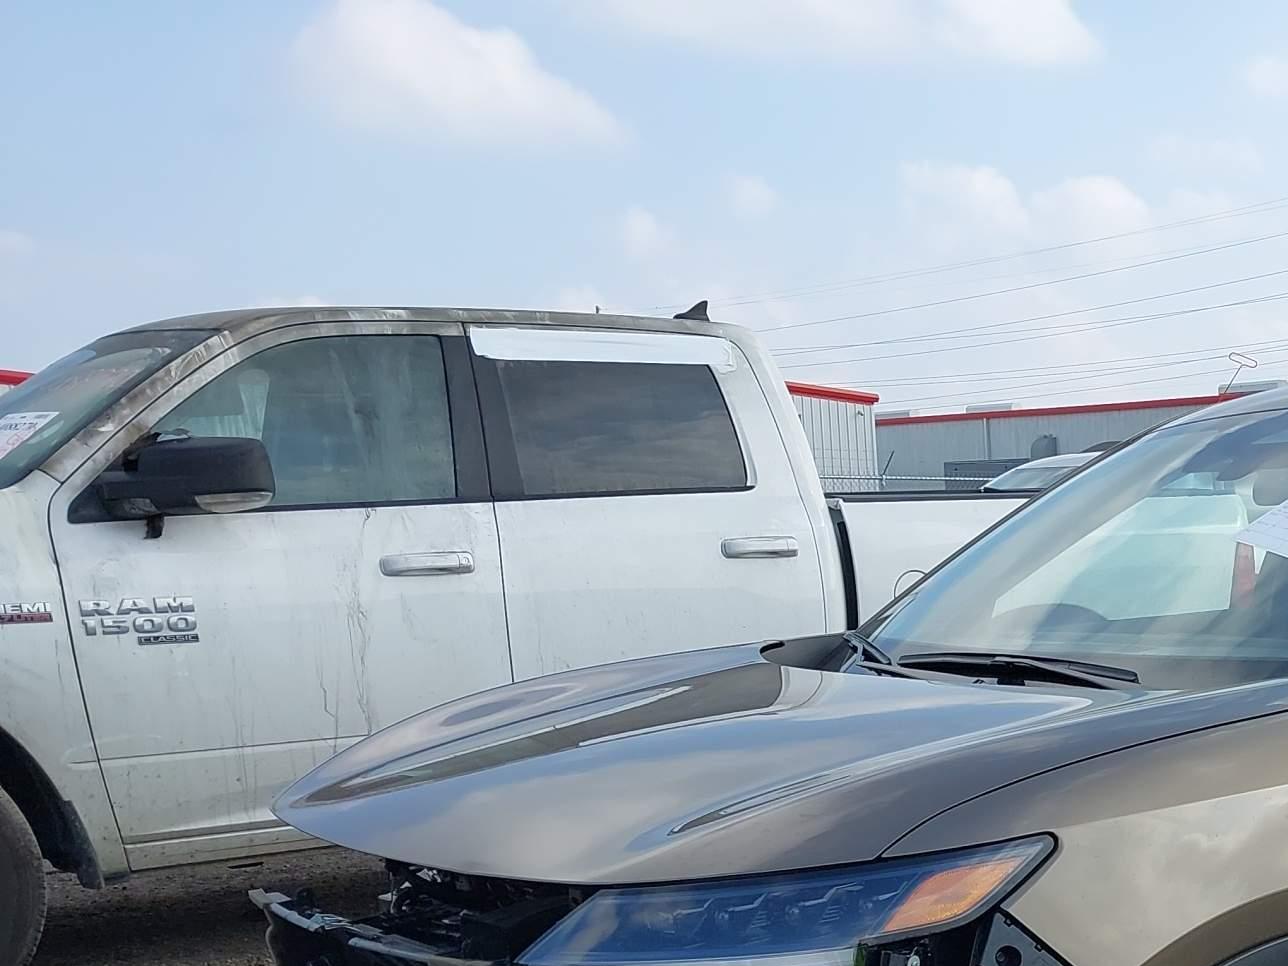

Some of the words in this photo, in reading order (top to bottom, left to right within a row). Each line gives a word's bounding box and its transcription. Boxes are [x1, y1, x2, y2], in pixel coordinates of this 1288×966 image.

[79, 596, 195, 617] RAM
[82, 615, 197, 636] 1500
[141, 634, 198, 644] CLASSIC
